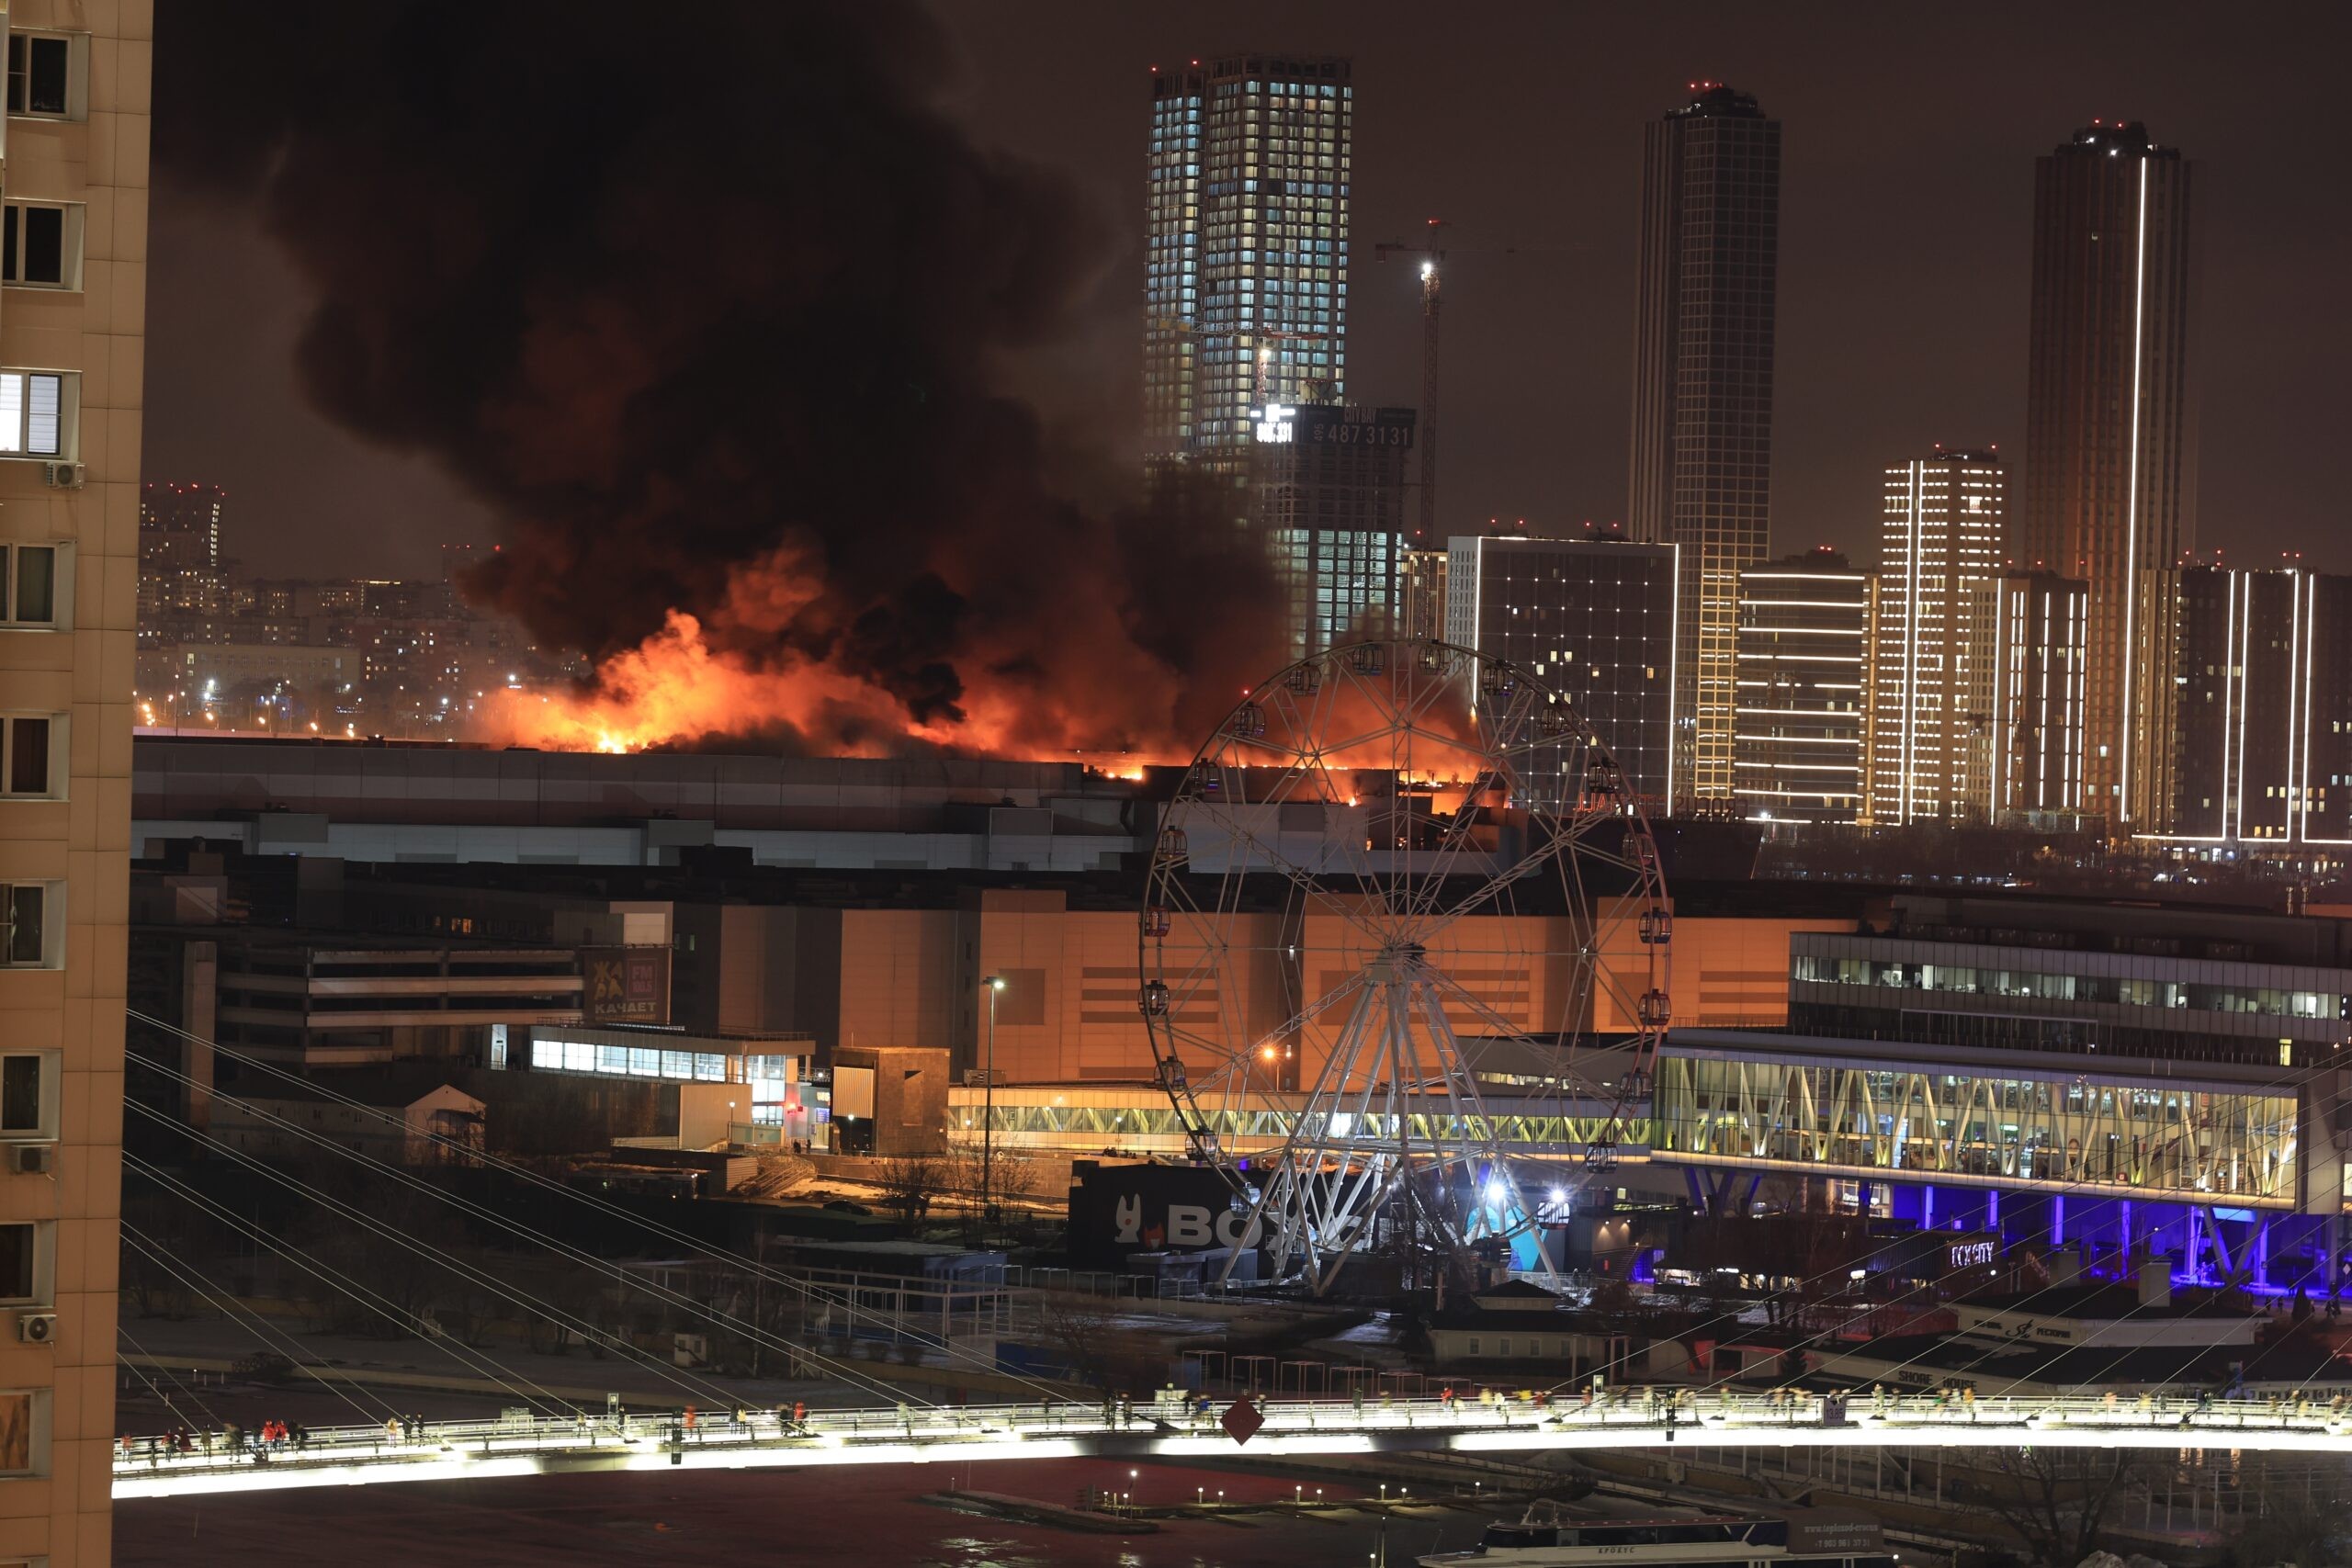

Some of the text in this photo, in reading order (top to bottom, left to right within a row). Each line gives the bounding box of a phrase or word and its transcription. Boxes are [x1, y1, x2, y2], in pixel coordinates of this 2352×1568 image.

[1328, 424, 1409, 446] 487 31 31
[632, 965, 653, 979] FM
[594, 1001, 657, 1014] КАЧАЕТ
[1898, 1370, 1978, 1393] SHORE HOUSE
